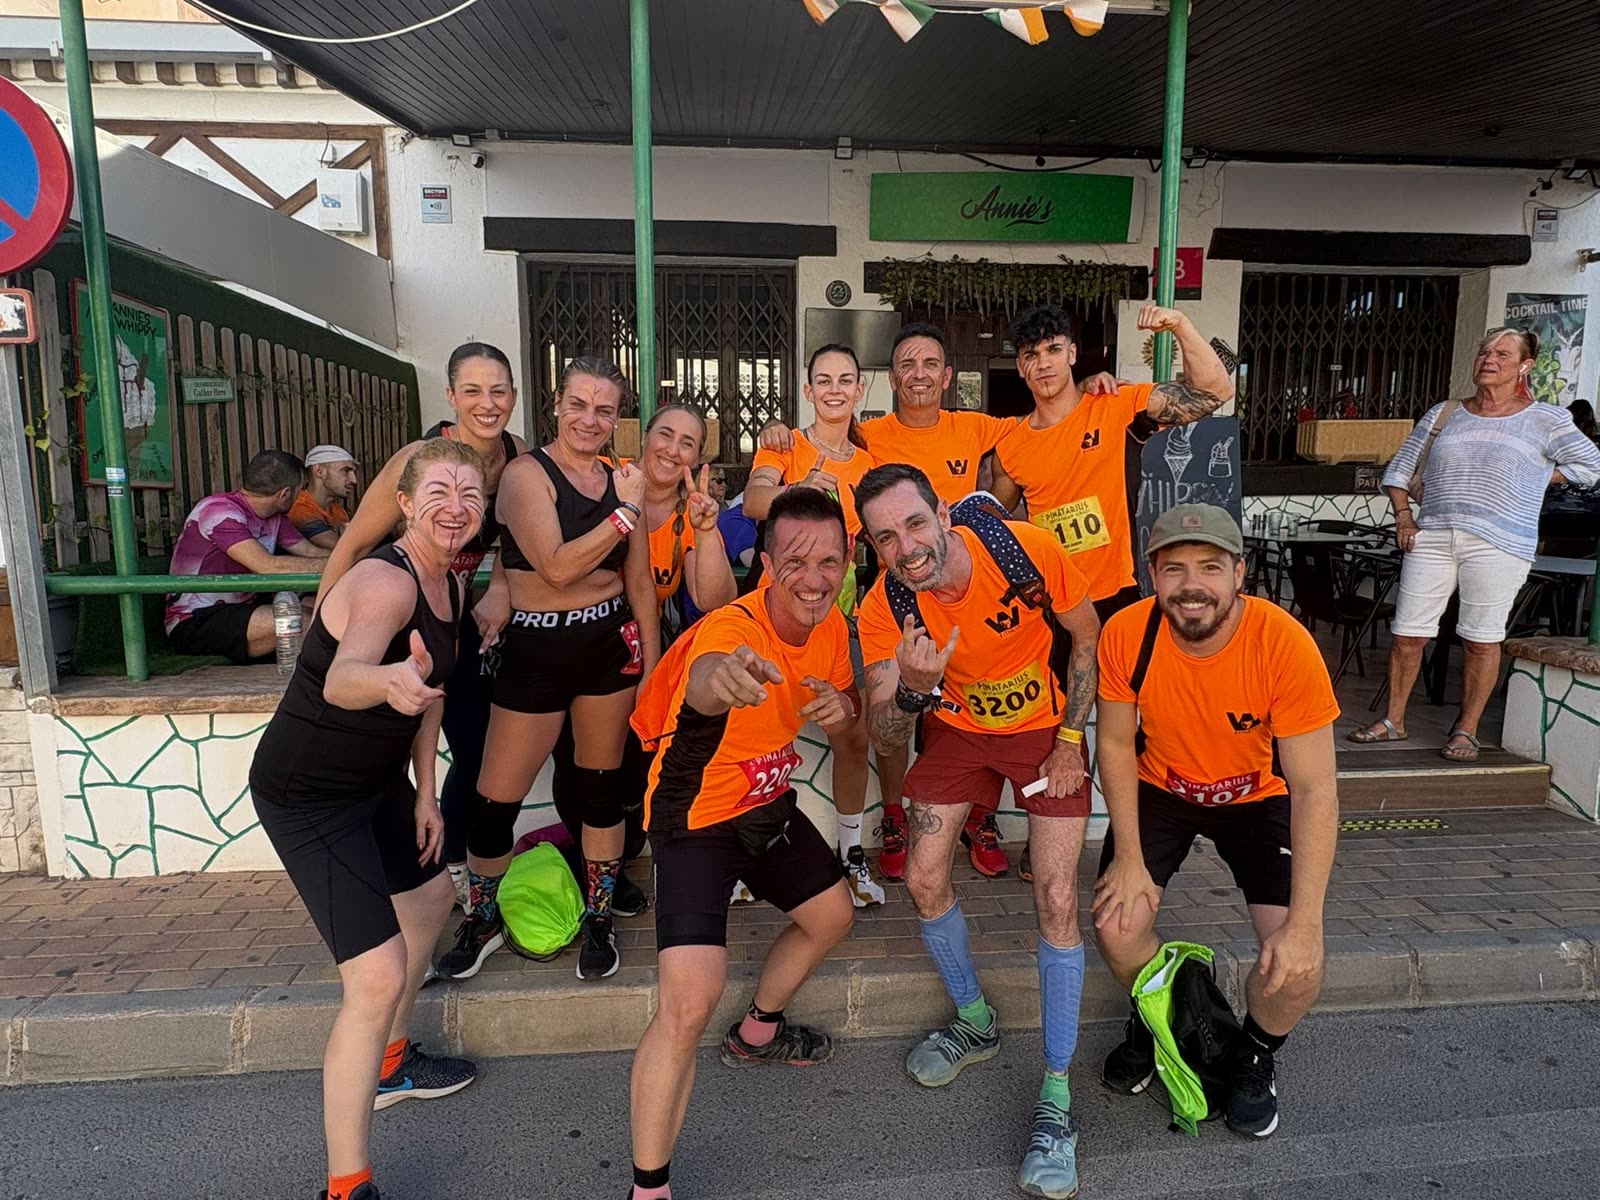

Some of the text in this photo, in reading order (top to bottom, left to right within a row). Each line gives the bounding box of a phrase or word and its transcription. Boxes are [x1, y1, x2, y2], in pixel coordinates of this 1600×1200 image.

[960, 185, 1055, 227] Annie's
[1504, 297, 1588, 320] COCKTAIL TIME
[113, 315, 157, 340] WHIPPY
[1054, 513, 1101, 544] 110
[511, 610, 559, 628] PRO
[564, 601, 610, 626] PRO
[968, 679, 1041, 717] 3200
